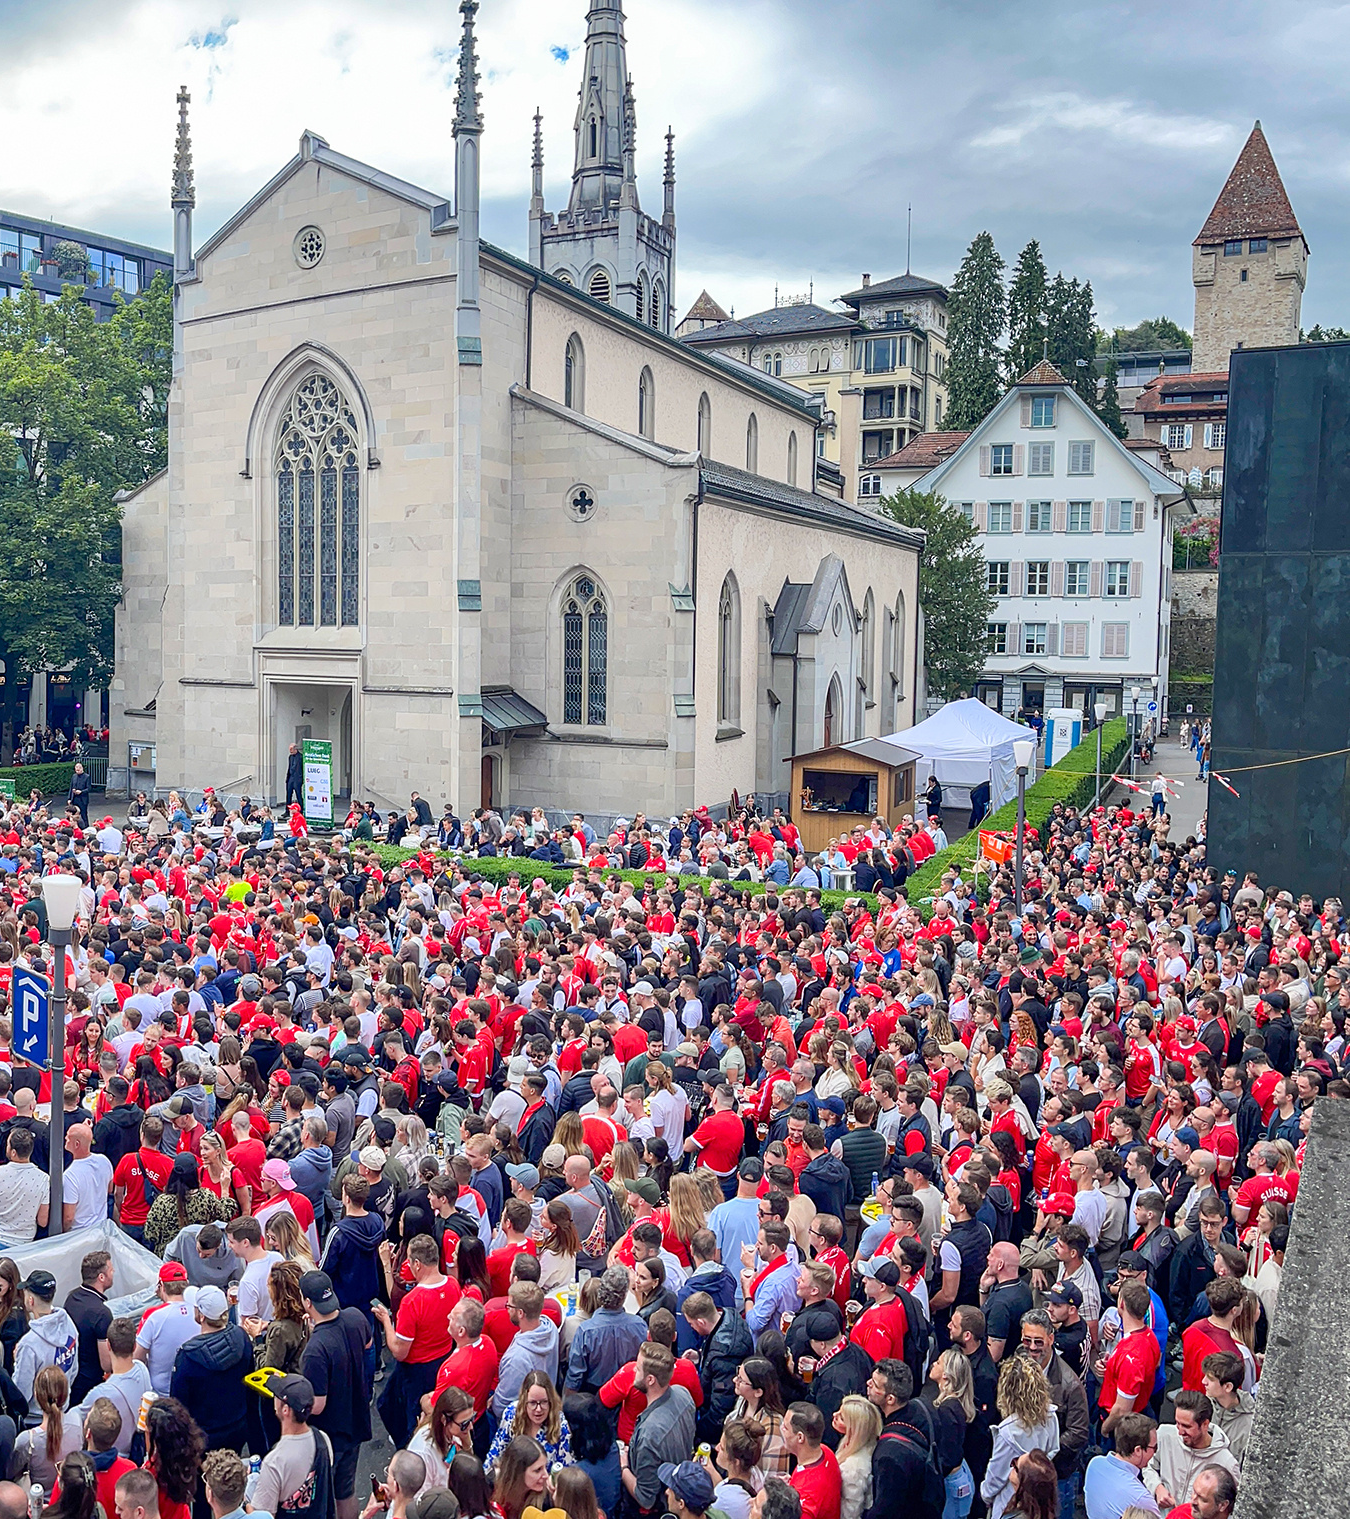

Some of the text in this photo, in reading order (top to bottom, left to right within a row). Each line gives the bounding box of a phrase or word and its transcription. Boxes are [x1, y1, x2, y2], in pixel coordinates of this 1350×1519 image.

[23, 990, 39, 1033] P
[1260, 1186, 1289, 1202] SUISSE
[56, 1346, 75, 1366] NASA
